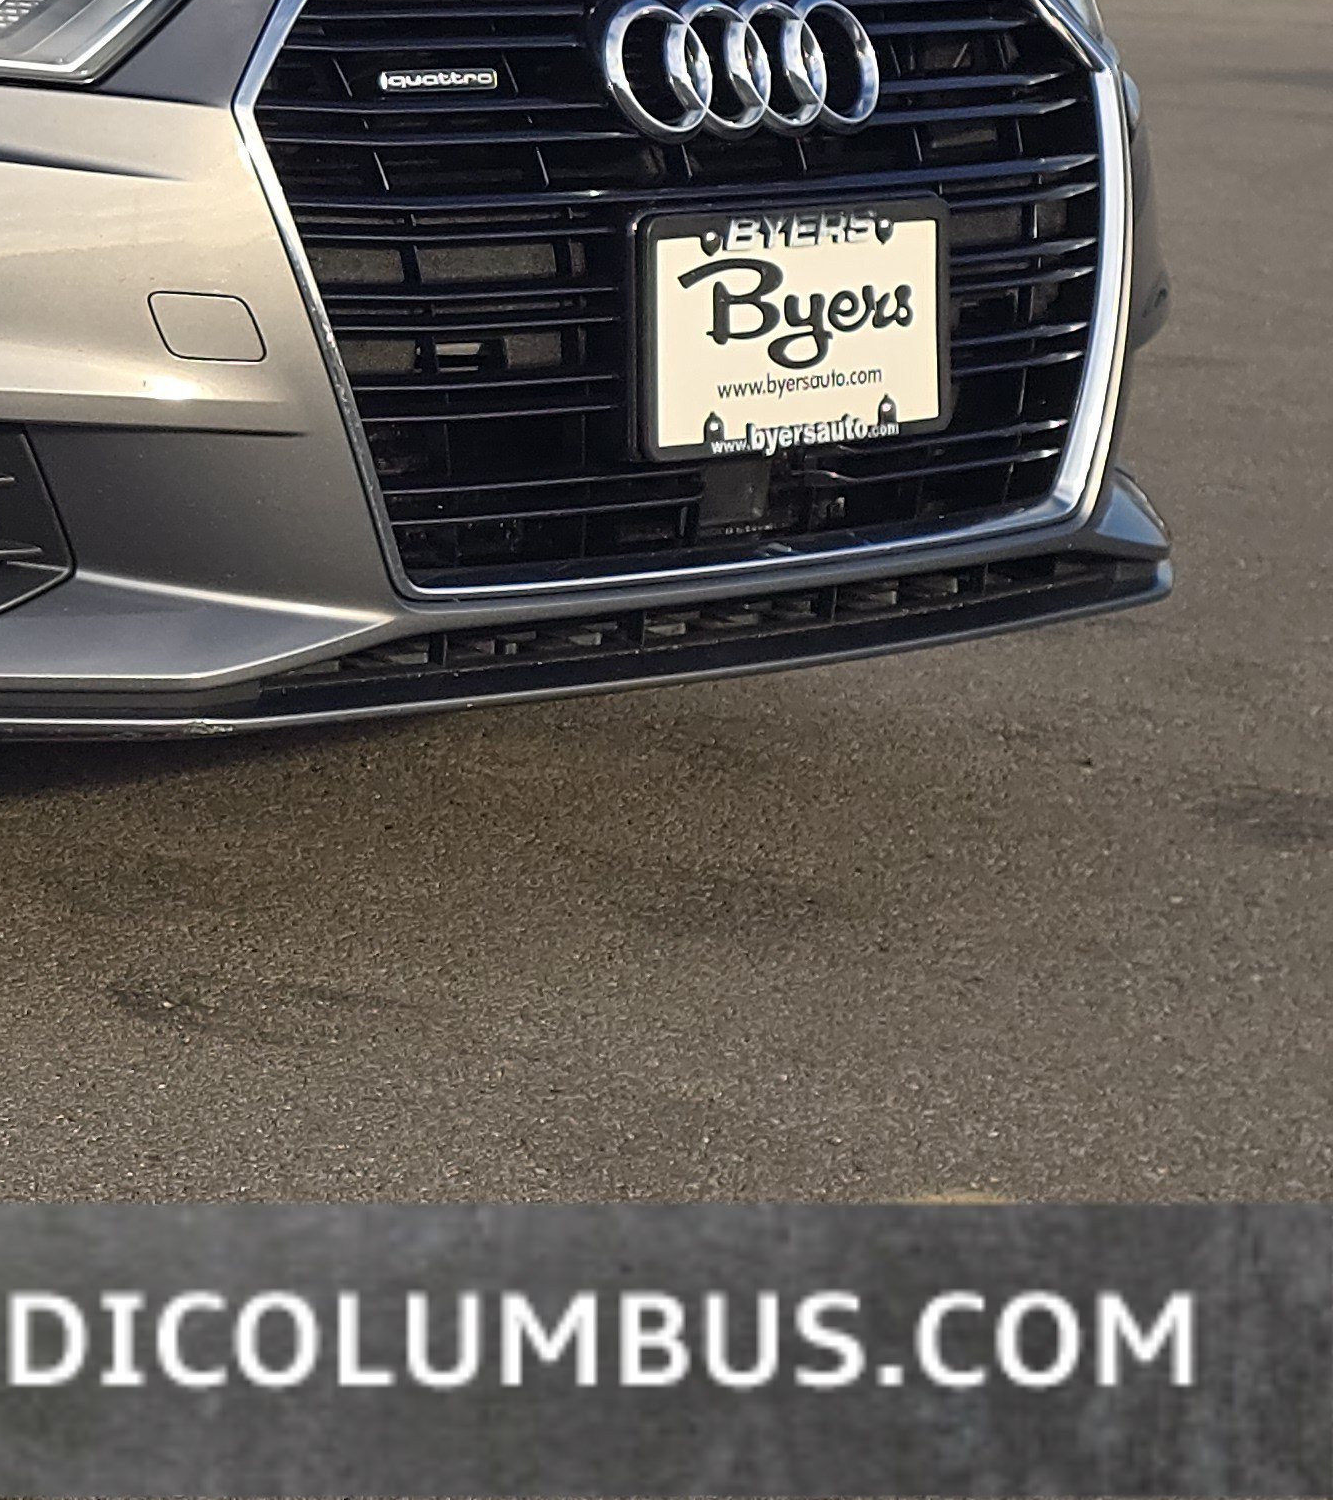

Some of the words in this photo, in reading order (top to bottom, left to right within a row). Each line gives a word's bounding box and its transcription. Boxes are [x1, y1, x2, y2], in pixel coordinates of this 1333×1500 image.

[388, 71, 492, 89] quattro
[726, 210, 878, 251] BYERS
[678, 258, 914, 369] Byers
[717, 367, 883, 399] www.byersauto.com
[711, 414, 899, 456] www.byersauto.com
